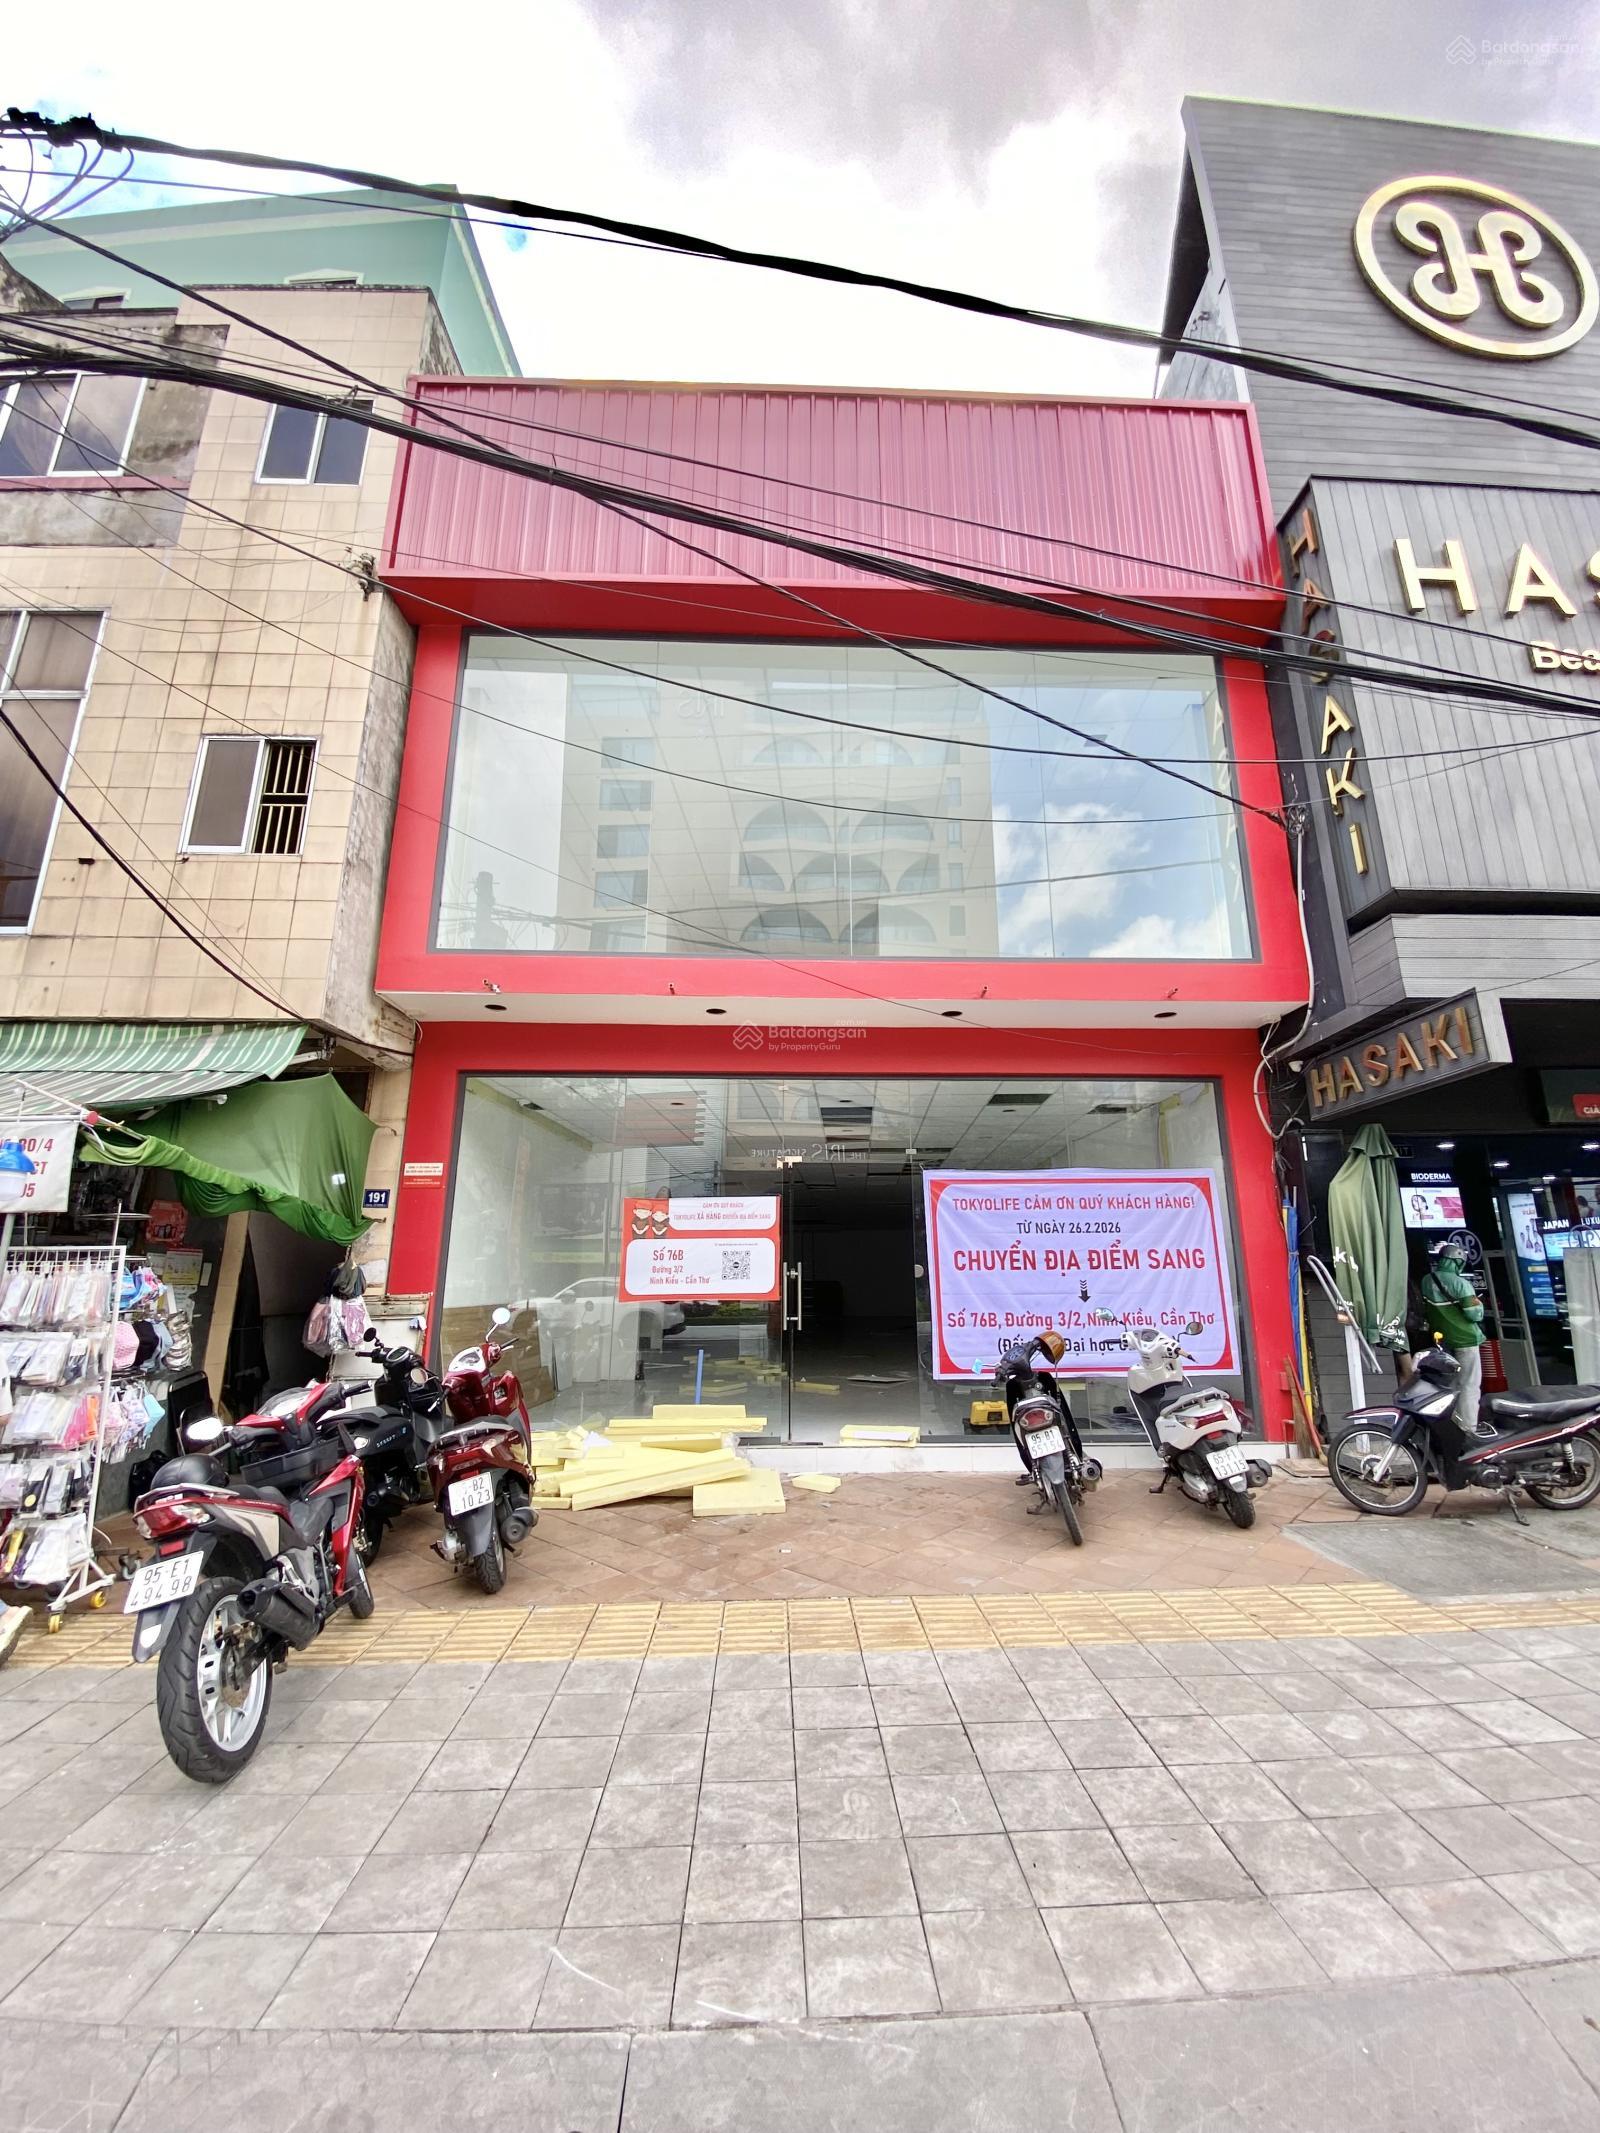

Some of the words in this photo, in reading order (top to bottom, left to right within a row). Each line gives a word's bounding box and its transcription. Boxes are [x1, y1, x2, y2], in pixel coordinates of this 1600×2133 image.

[1286, 508, 1368, 876] HASAKI
[1311, 1007, 1473, 1108] HASAKI
[1411, 1172, 1451, 1180] BIODERMA
[368, 1192, 386, 1203] 191
[953, 1198, 1020, 1210] TOKYOLIFE
[1024, 1194, 1051, 1209] CẢM
[1056, 1196, 1075, 1209] ƠN
[1079, 1194, 1104, 1209] QUÝ
[1108, 1194, 1151, 1209] KHÁCH
[1155, 1193, 1196, 1209] HÀNG!
[1017, 1220, 1031, 1234] TỪ
[1036, 1219, 1066, 1234] NGÀY
[1069, 1222, 1121, 1234] 26.2.2026
[1543, 1219, 1570, 1230] JAPAN
[653, 1246, 666, 1260] Số
[668, 1250, 684, 1260] 76B
[953, 1240, 1036, 1271] CHUYỂN
[1045, 1249, 1080, 1277] ĐỊA
[1088, 1240, 1140, 1270] ĐIỂM
[1148, 1248, 1205, 1269] SANG
[674, 1265, 684, 1274] 3/2
[947, 1308, 966, 1327] Số
[971, 1312, 1001, 1330] 76B,
[1005, 1310, 1053, 1330] Đường
[1123, 1308, 1156, 1328] Kiều,
[1160, 1307, 1186, 1326] Cần
[1189, 1311, 1214, 1325] Thơ
[144, 1559, 190, 1585] 95-E1
